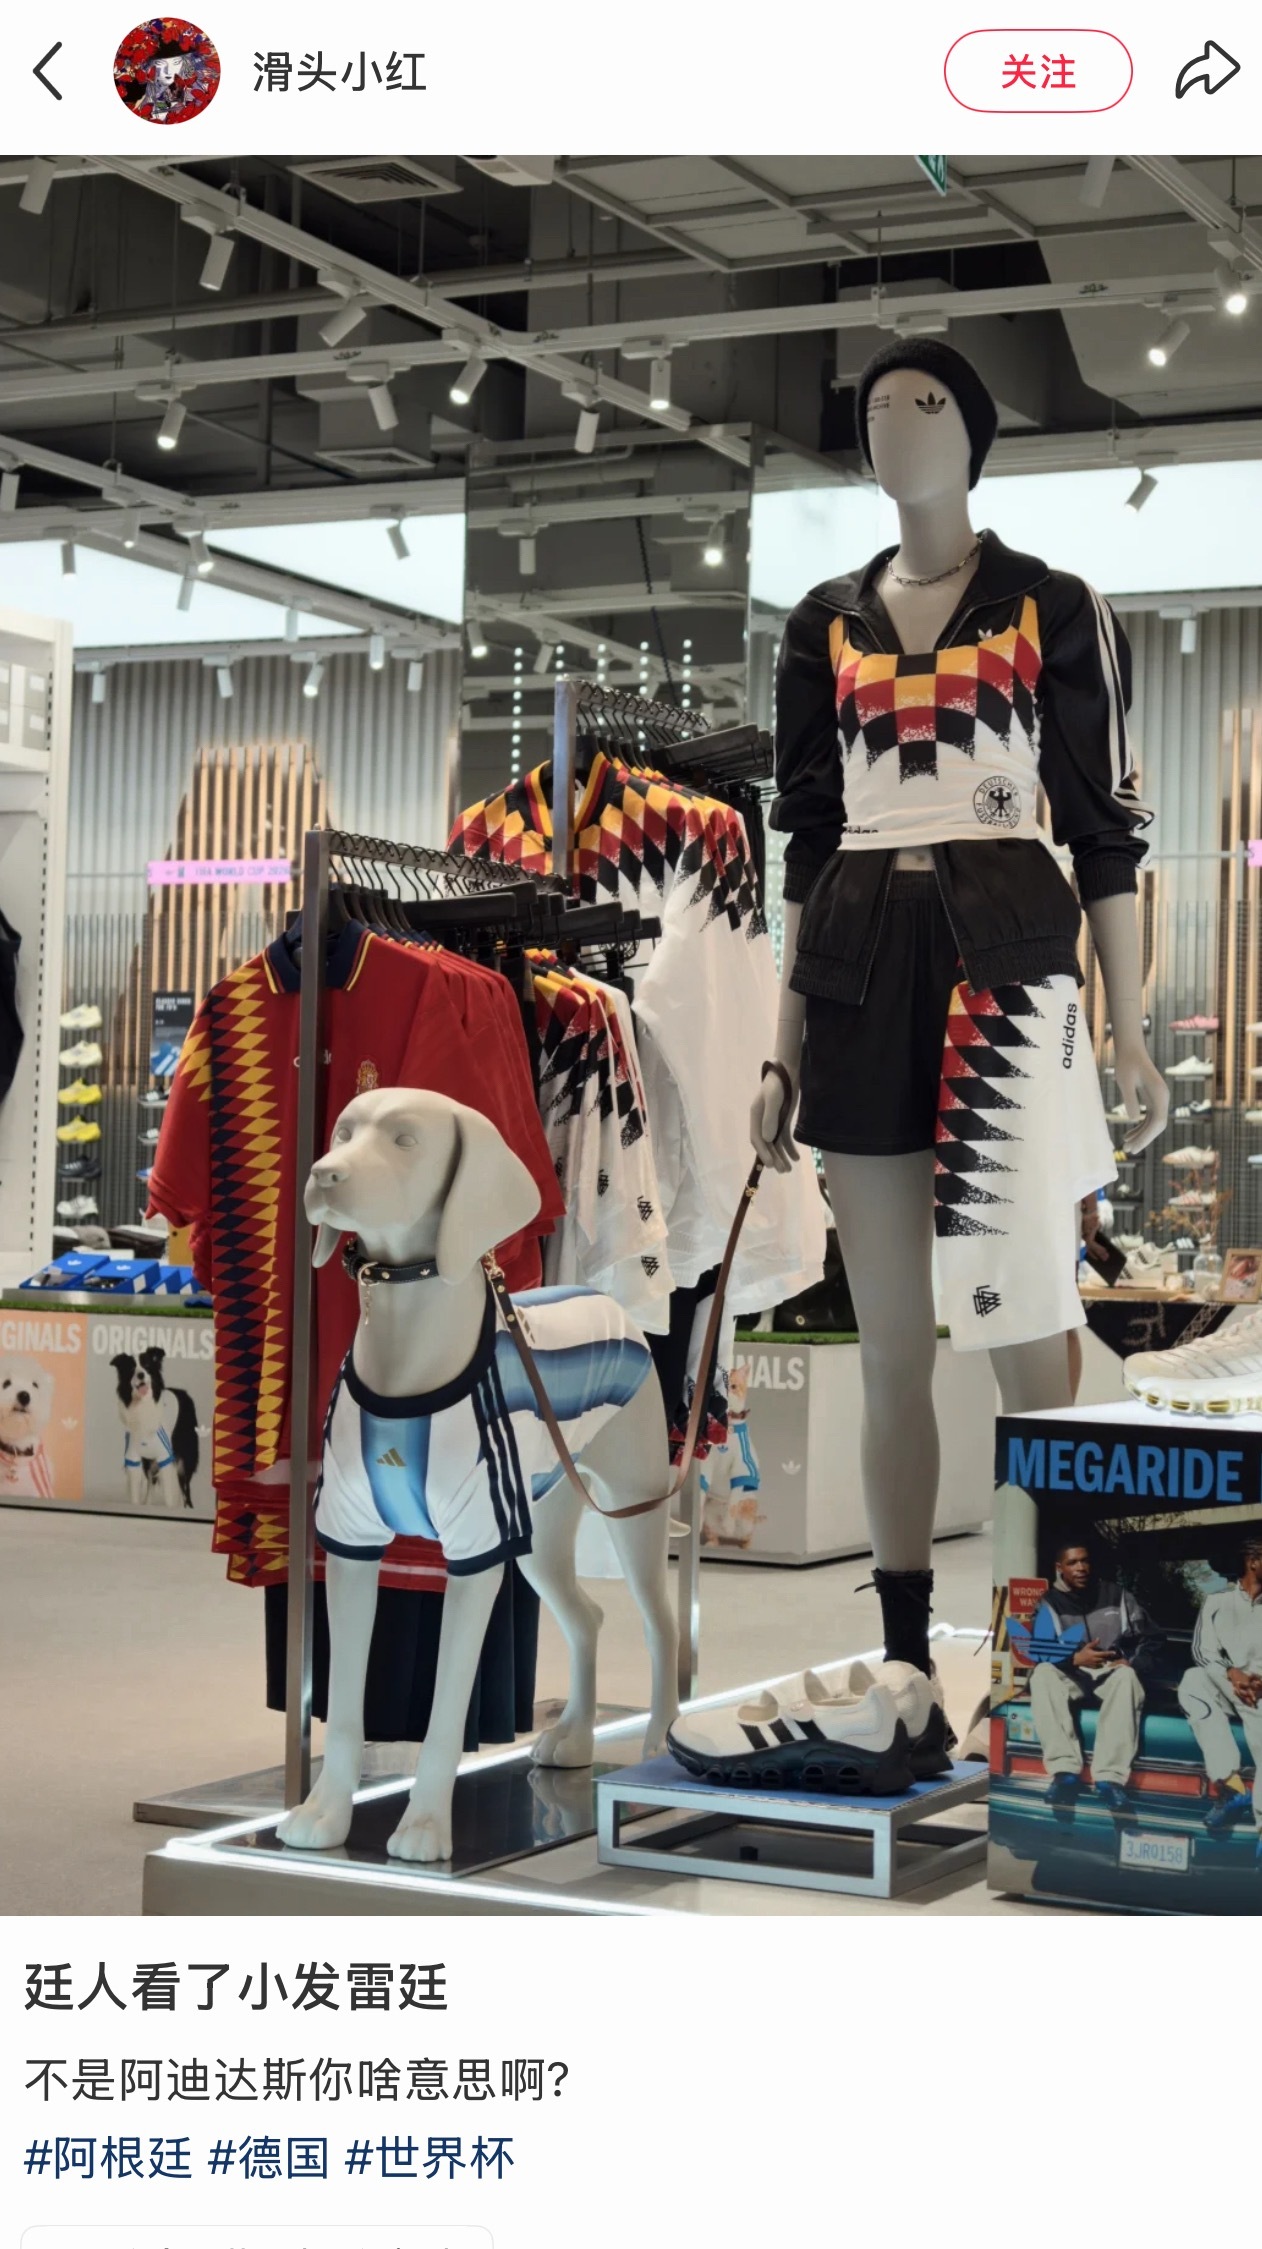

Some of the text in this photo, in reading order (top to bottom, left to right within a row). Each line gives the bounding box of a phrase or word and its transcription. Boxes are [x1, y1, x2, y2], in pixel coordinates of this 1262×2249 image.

[1061, 1002, 1077, 1070] adidas
[92, 1325, 214, 1360] ORIGINALS
[1008, 1437, 1244, 1502] MEGARIDE
